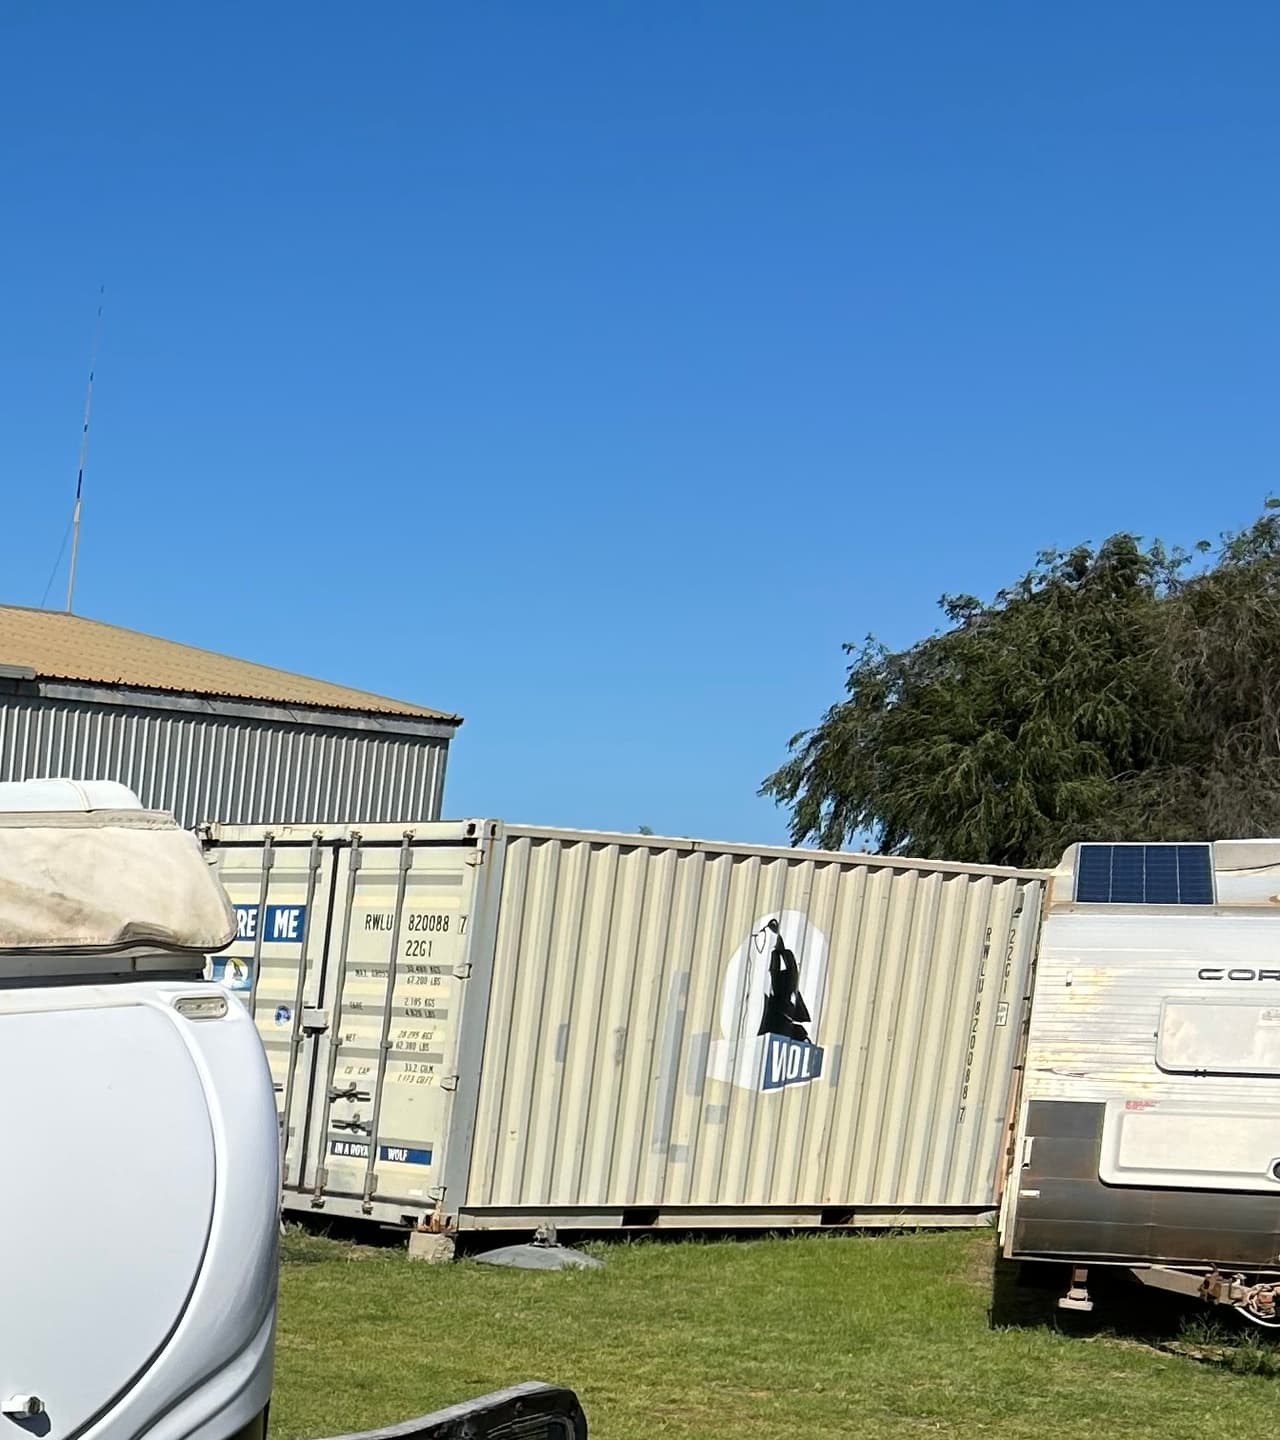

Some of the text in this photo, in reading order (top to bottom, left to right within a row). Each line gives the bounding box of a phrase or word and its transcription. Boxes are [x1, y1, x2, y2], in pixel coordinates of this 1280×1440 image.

[273, 909, 300, 939] ME
[364, 913, 467, 934] RWLU 820088 7
[405, 939, 433, 957] 22G1
[350, 1145, 370, 1159] ROYA
[387, 1147, 409, 1161] WOLF
